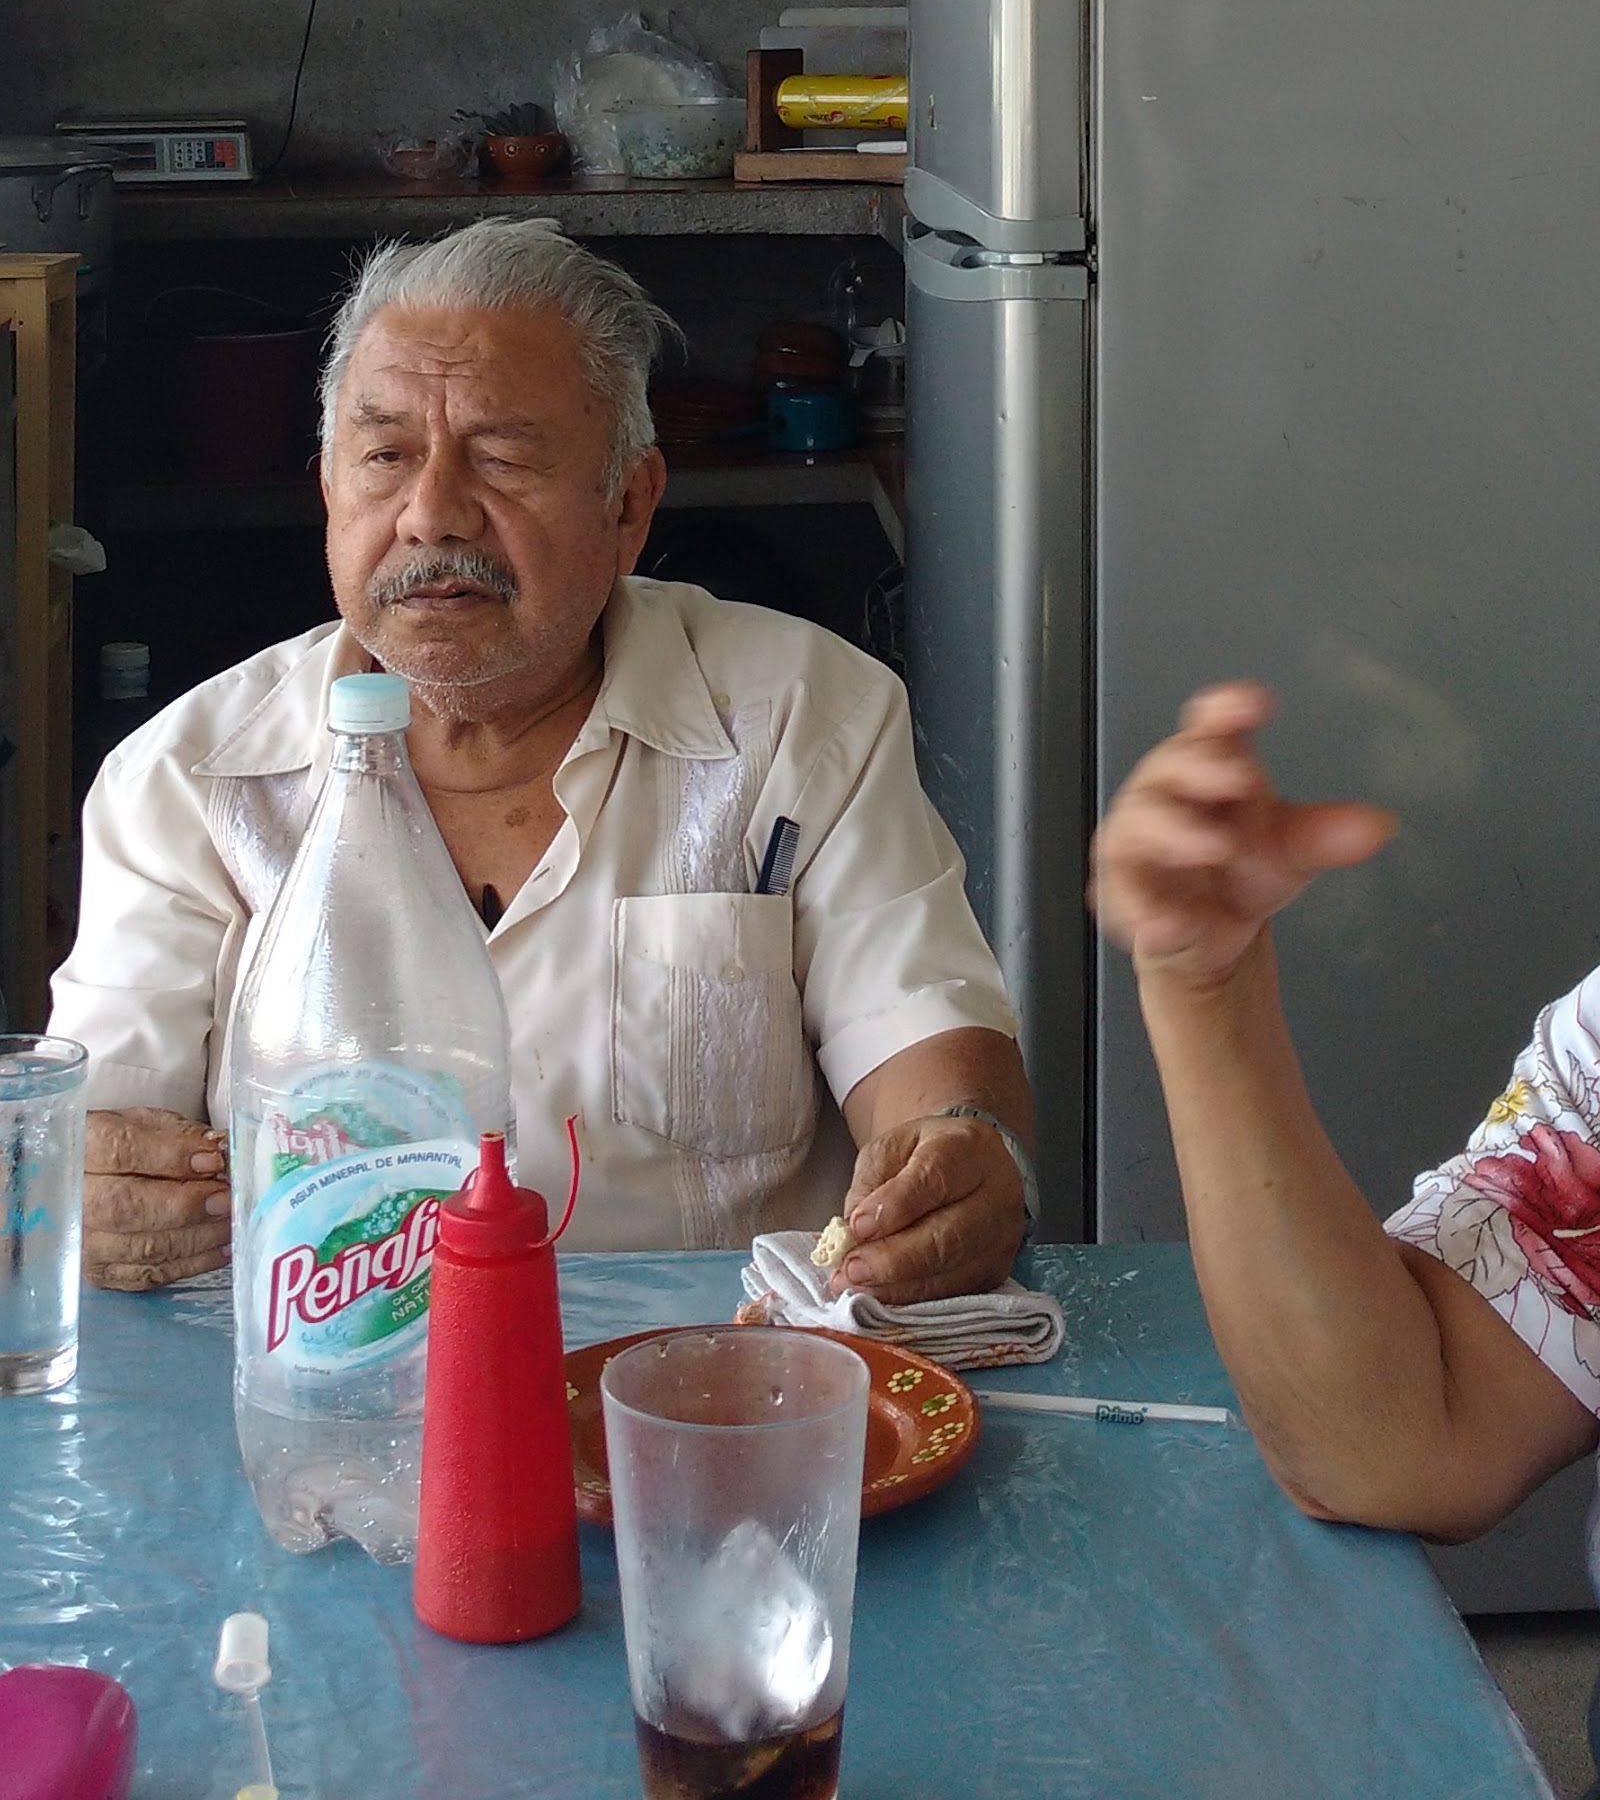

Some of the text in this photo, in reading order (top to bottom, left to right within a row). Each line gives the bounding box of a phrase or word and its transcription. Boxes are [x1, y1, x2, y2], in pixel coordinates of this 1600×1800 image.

[289, 1182, 319, 1209] AGUA
[319, 1162, 372, 1188] MINERAL
[375, 1156, 393, 1170] DE
[397, 1152, 463, 1169] MANANTIAL
[268, 1195, 441, 1352] Peñafi
[392, 1292, 408, 1307] DE
[1096, 1404, 1144, 1425] Primo
